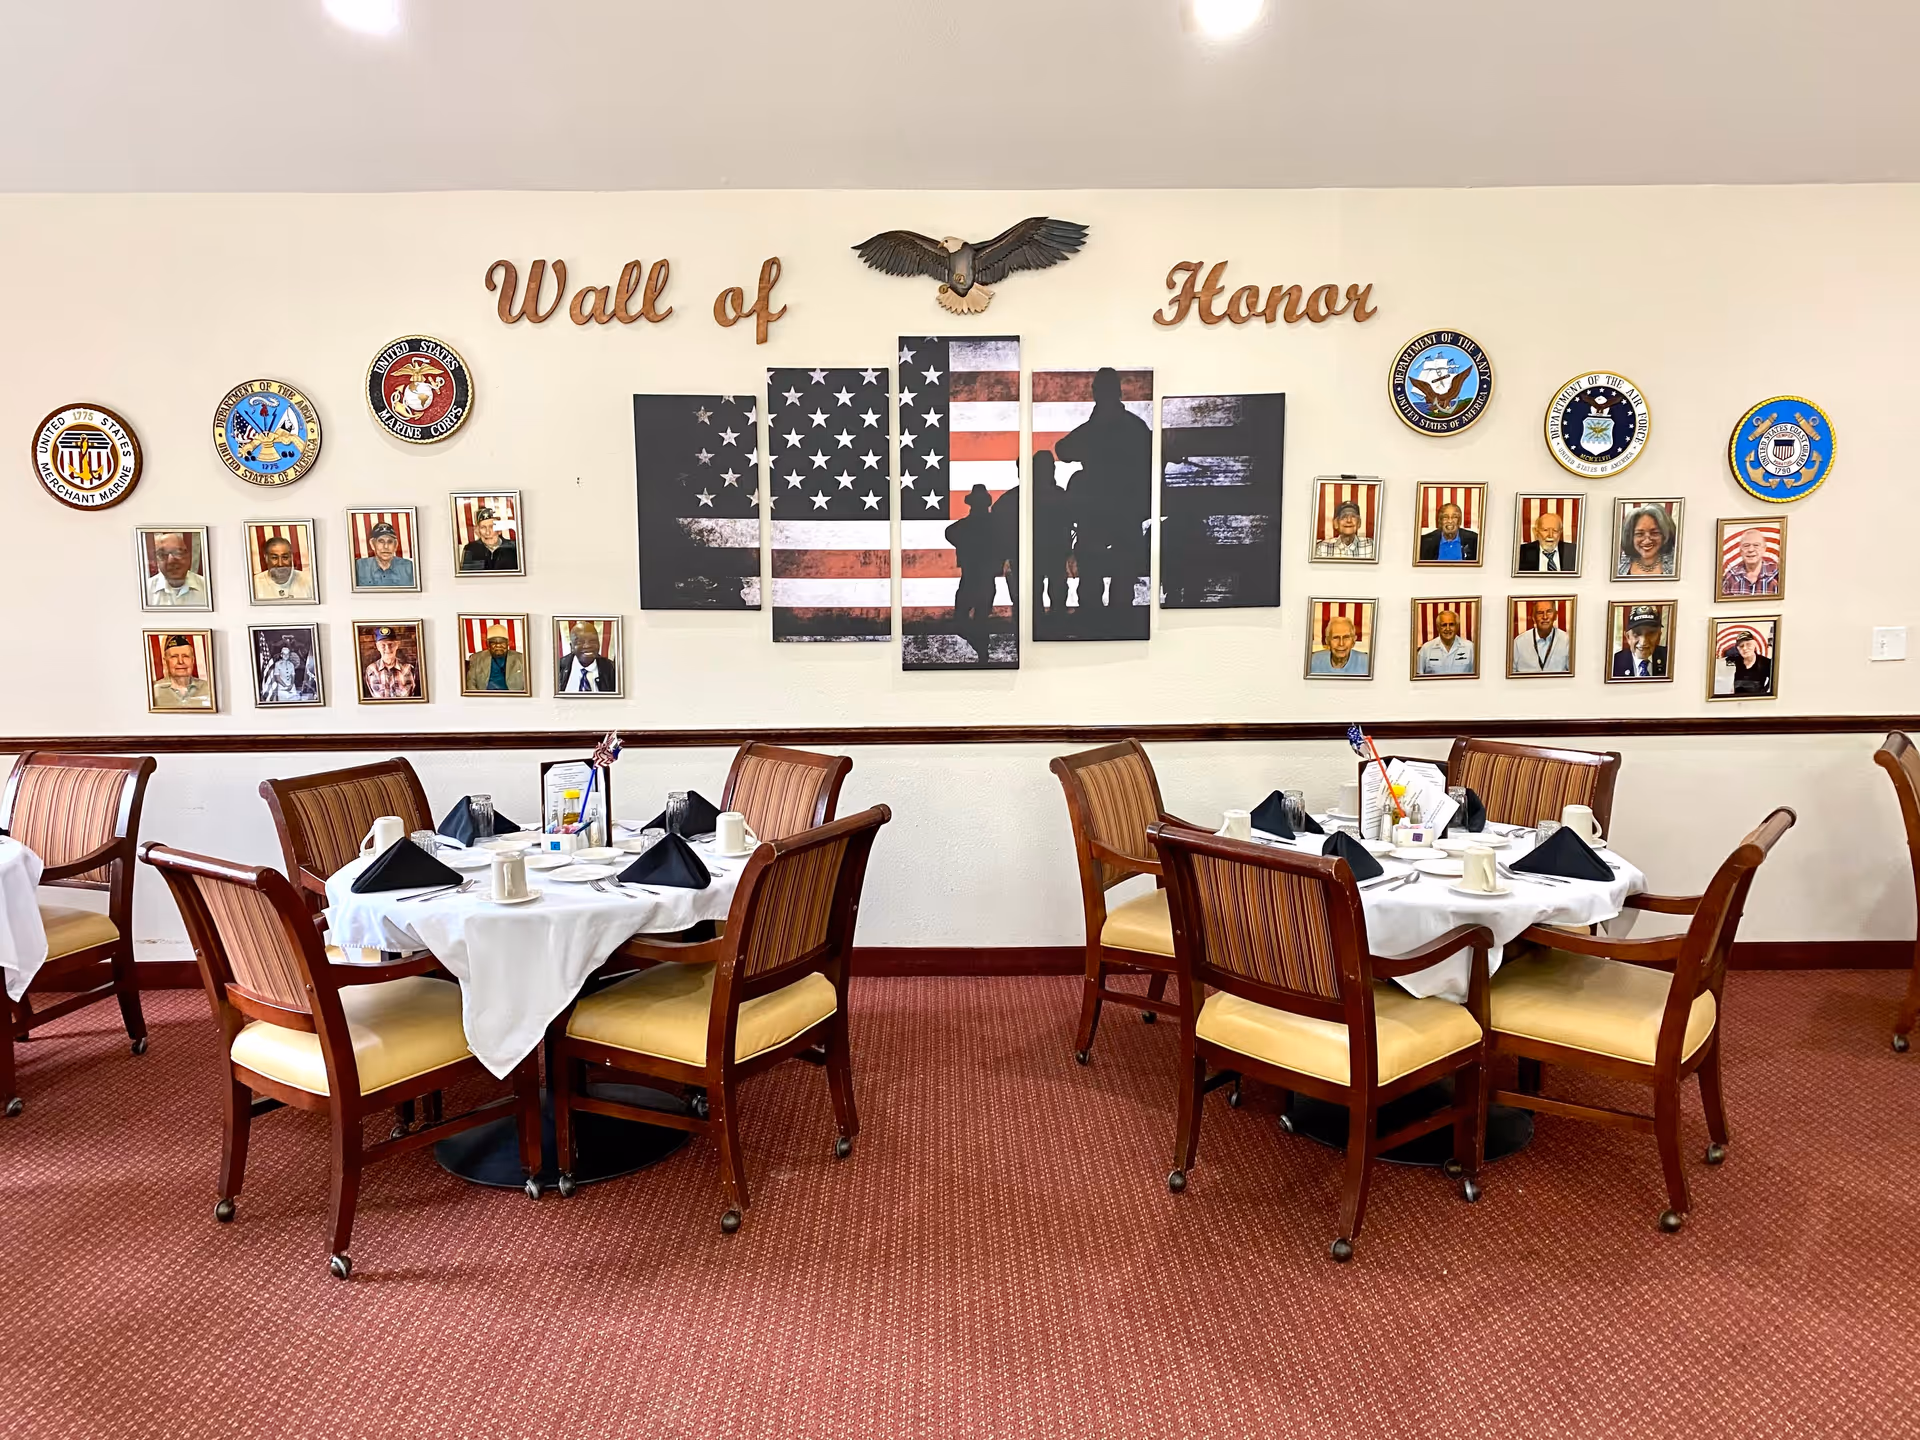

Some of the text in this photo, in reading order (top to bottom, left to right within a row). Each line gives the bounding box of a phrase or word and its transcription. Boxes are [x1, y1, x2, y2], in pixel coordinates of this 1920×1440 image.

[484, 256, 1378, 344] Wall of Honor
[374, 341, 459, 374] UNITED STATES
[1395, 333, 1490, 384] DEPARTMENT OF THE NAVY
[73, 411, 94, 421] 1775
[216, 382, 316, 428] DEPARTMENT OF THE ARMY
[378, 406, 462, 438] MARINE CORPS
[1397, 392, 1488, 430] UNITED STATES OF AMERICA
[1550, 375, 1647, 445] DEPARTMENT OF THE AIR FORCE
[40, 417, 131, 456] UNITED STATES
[1760, 425, 1808, 467] UNITED STATES COAST GUARD
[219, 438, 318, 483] UNITED STATES OF AMERICA
[1558, 448, 1574, 465] UNITED
[1576, 464, 1598, 472] STATES
[41, 463, 131, 503] MERCHANT MARINE
